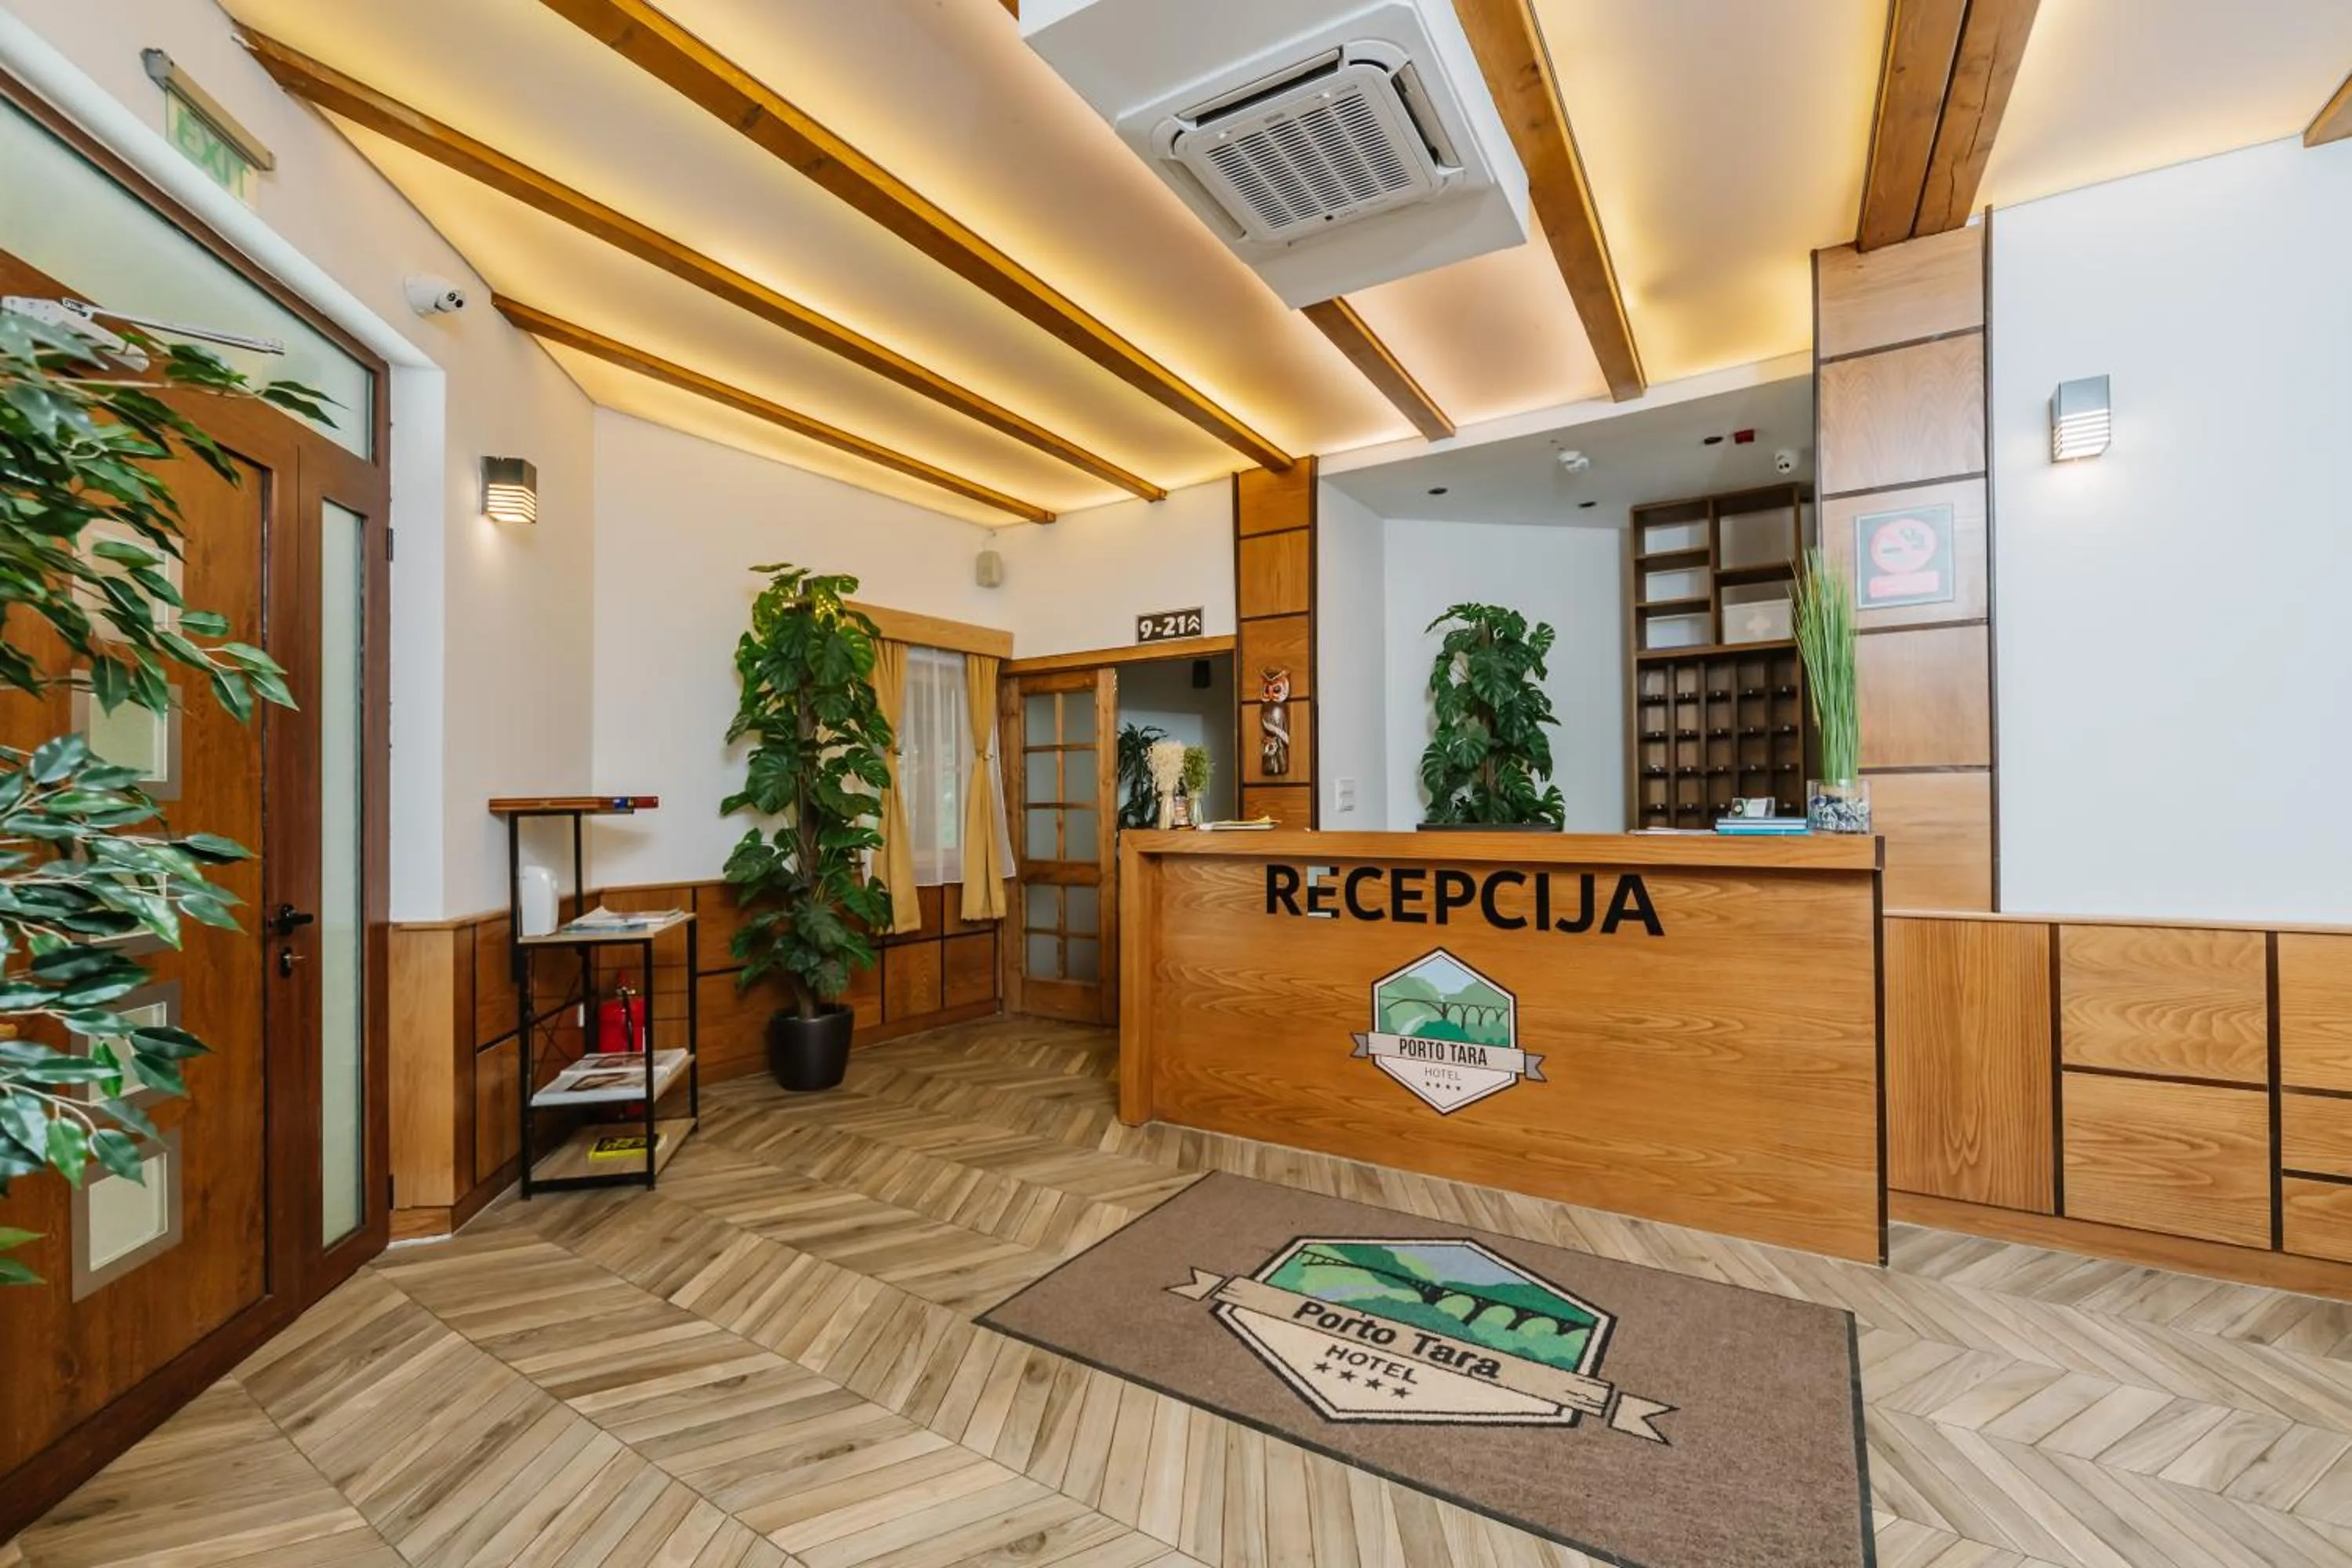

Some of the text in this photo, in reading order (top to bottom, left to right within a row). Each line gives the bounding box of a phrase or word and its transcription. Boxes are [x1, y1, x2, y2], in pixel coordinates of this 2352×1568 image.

[1139, 615, 1186, 639] 9-21
[1266, 864, 1664, 936] RECEPCIJA
[1399, 1037, 1487, 1065] PORTO TARA
[1425, 1066, 1461, 1080] HOTEL
[1293, 1300, 1502, 1379] Porto Tara
[1324, 1344, 1418, 1385] HOTEL
